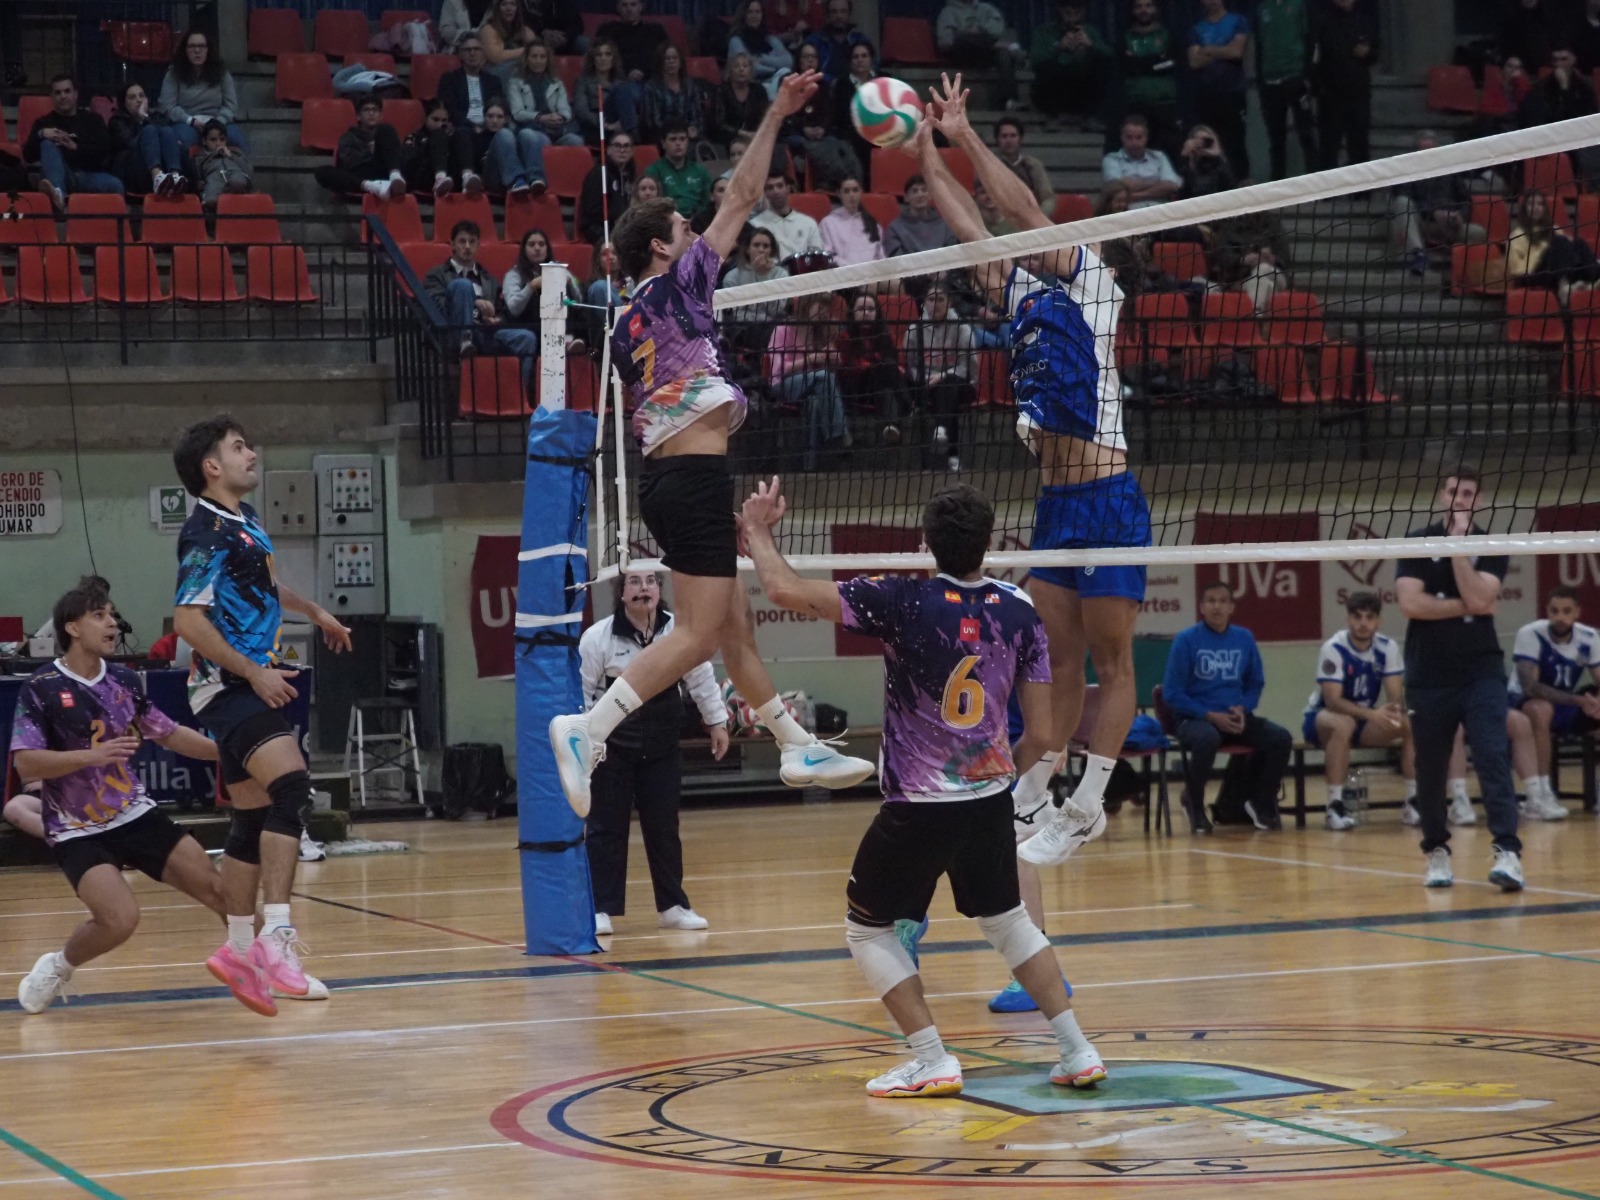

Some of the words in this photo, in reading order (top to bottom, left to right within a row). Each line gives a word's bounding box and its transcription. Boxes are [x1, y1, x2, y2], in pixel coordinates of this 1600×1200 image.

[631, 337, 656, 392] 7
[29, 471, 44, 486] DE
[748, 586, 761, 596] de
[1218, 562, 1298, 599] UVa
[941, 655, 986, 729] 6
[90, 719, 106, 747] 2
[134, 761, 192, 790] illa
